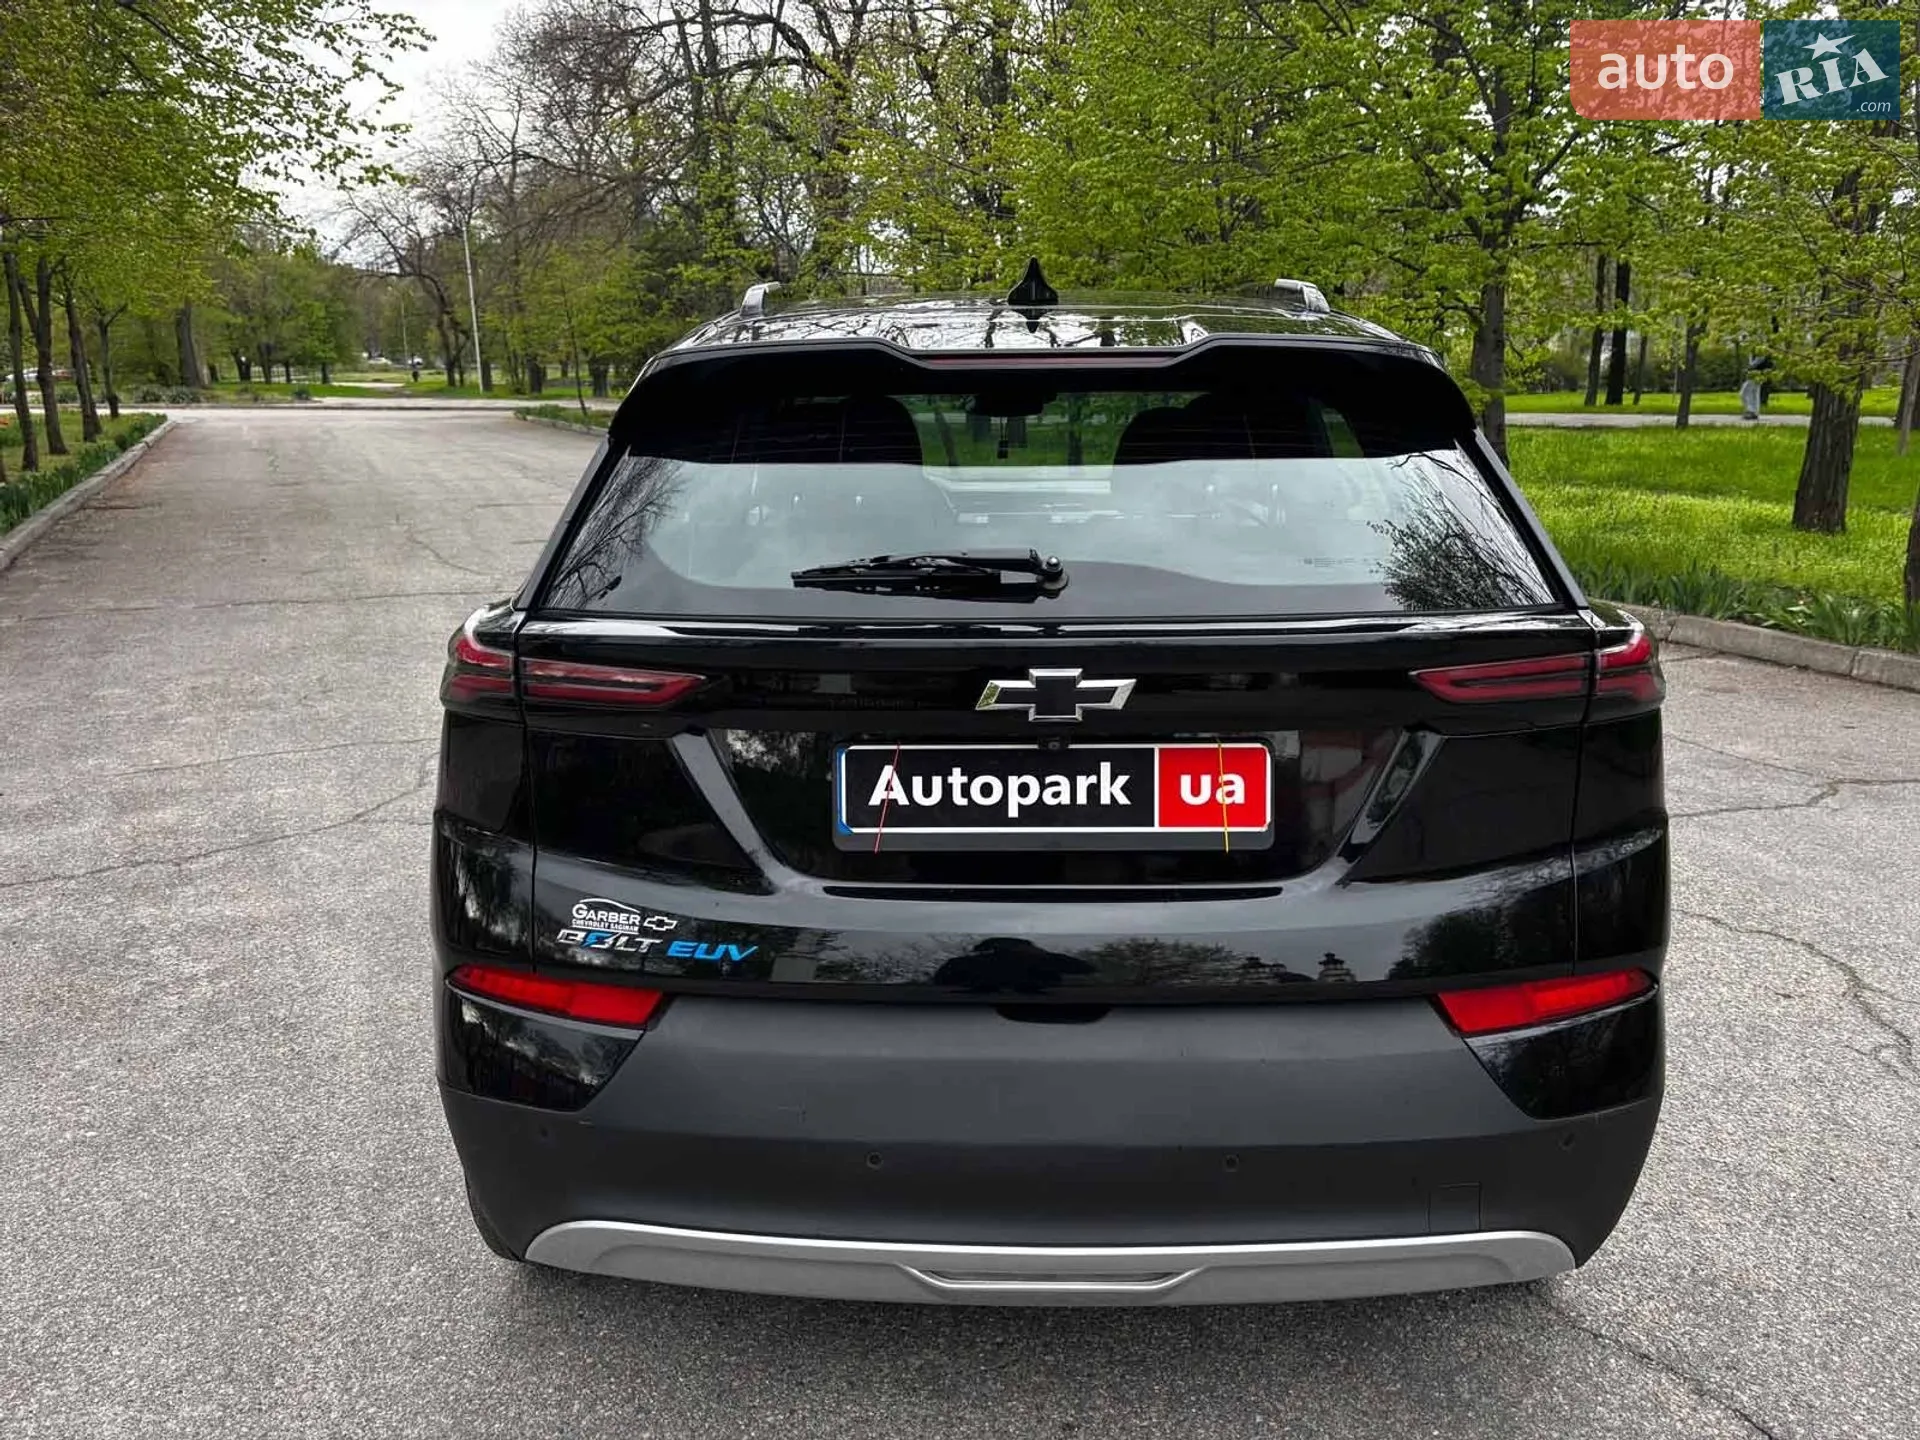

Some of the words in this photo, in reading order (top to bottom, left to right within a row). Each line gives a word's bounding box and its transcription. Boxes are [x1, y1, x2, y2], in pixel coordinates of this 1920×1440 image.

[868, 762, 1132, 817] Autopark
[1180, 773, 1246, 804] ua
[572, 903, 641, 925] GARBER
[556, 928, 663, 953] BOLT
[667, 941, 758, 961] EUV
